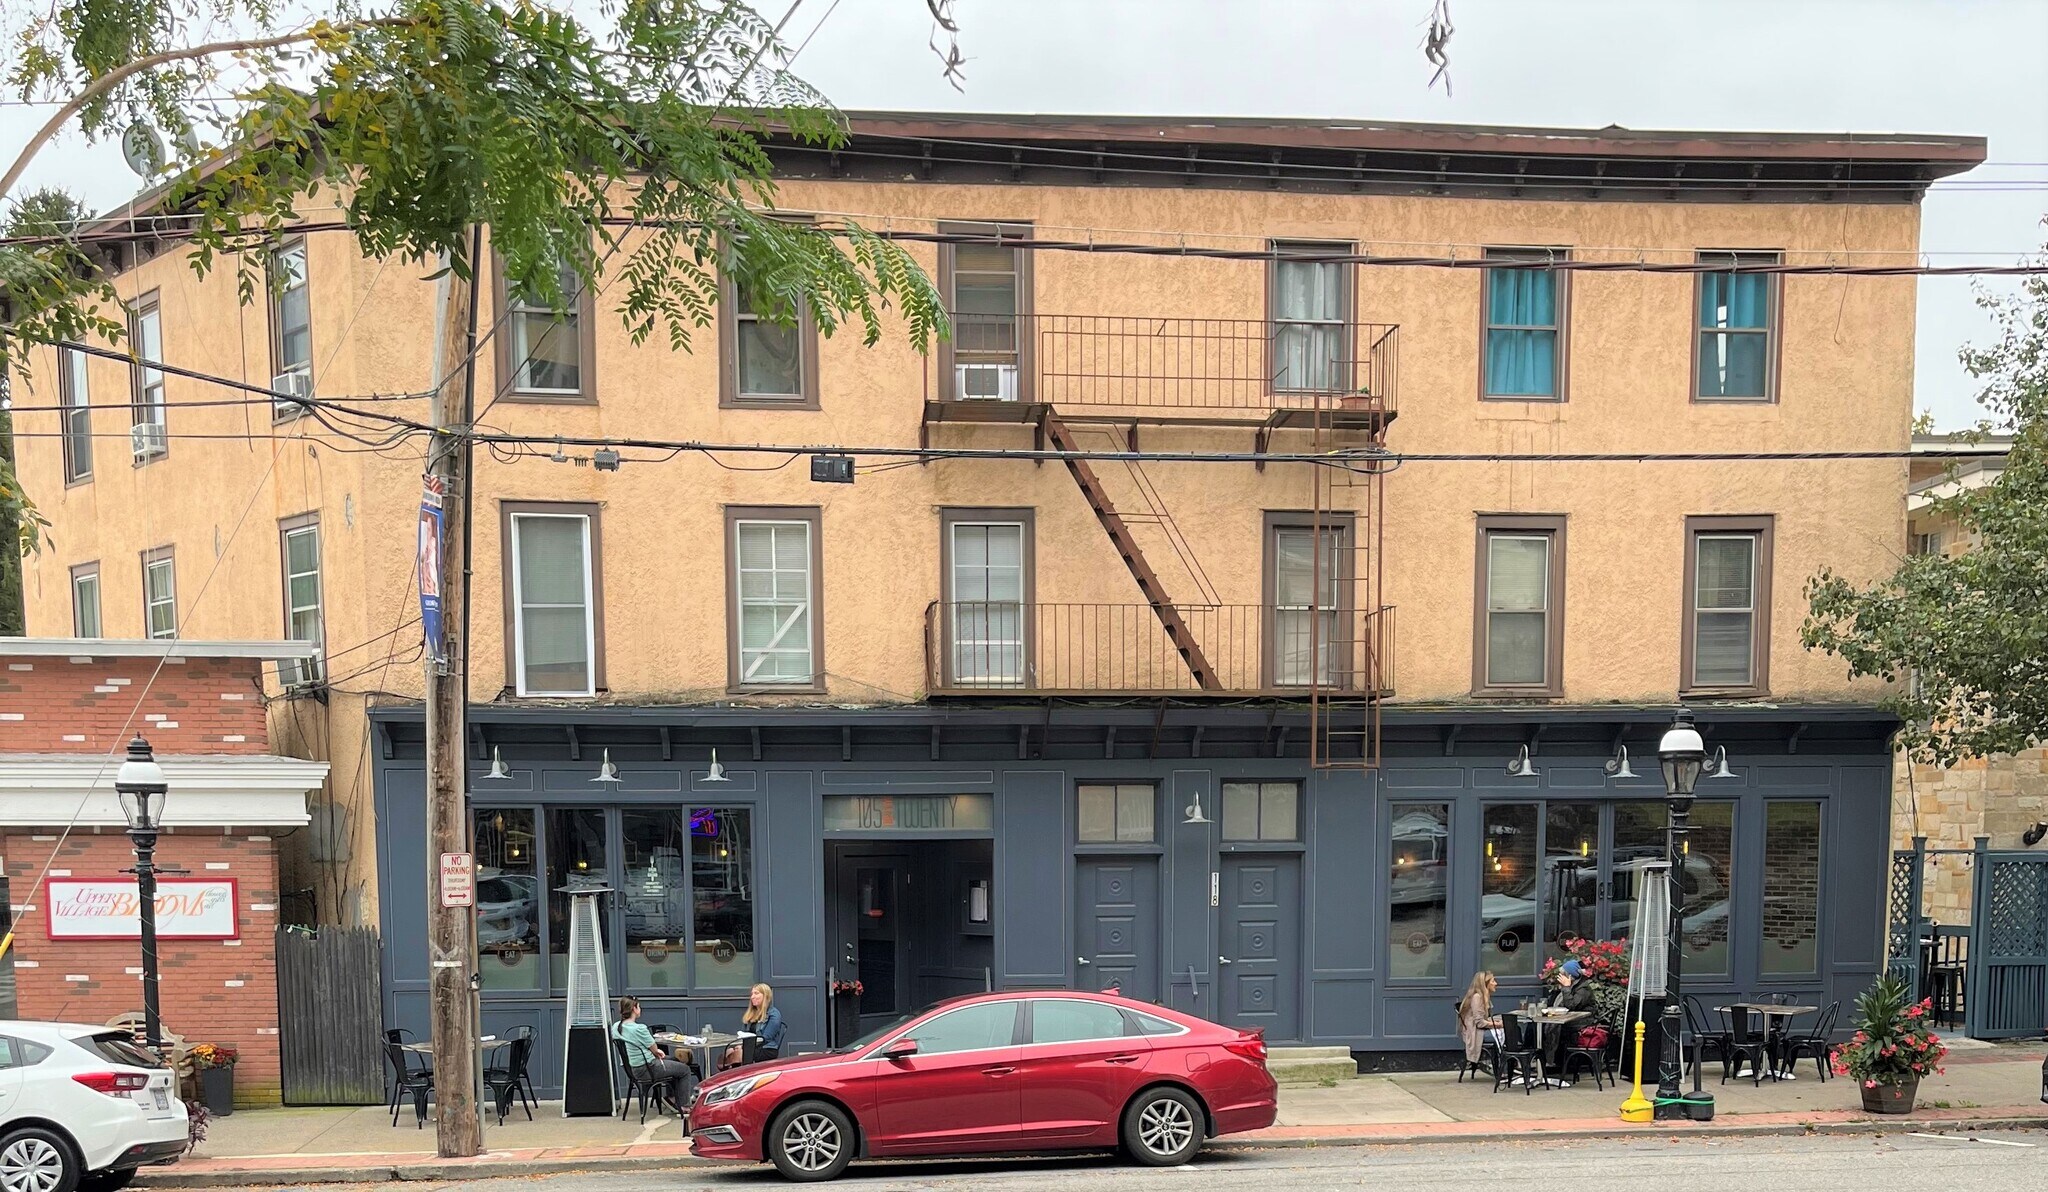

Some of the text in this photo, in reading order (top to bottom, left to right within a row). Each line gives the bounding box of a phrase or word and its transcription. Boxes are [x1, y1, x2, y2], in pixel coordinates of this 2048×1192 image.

[895, 796, 959, 829] TWENTY
[451, 855, 462, 866] NO
[443, 866, 470, 875] PARKING
[76, 888, 117, 907] UPPER
[55, 900, 110, 918] VILLAGE
[1501, 939, 1516, 947] PLAY
[505, 950, 515, 958] EAT
[716, 948, 730, 957] LIVE
